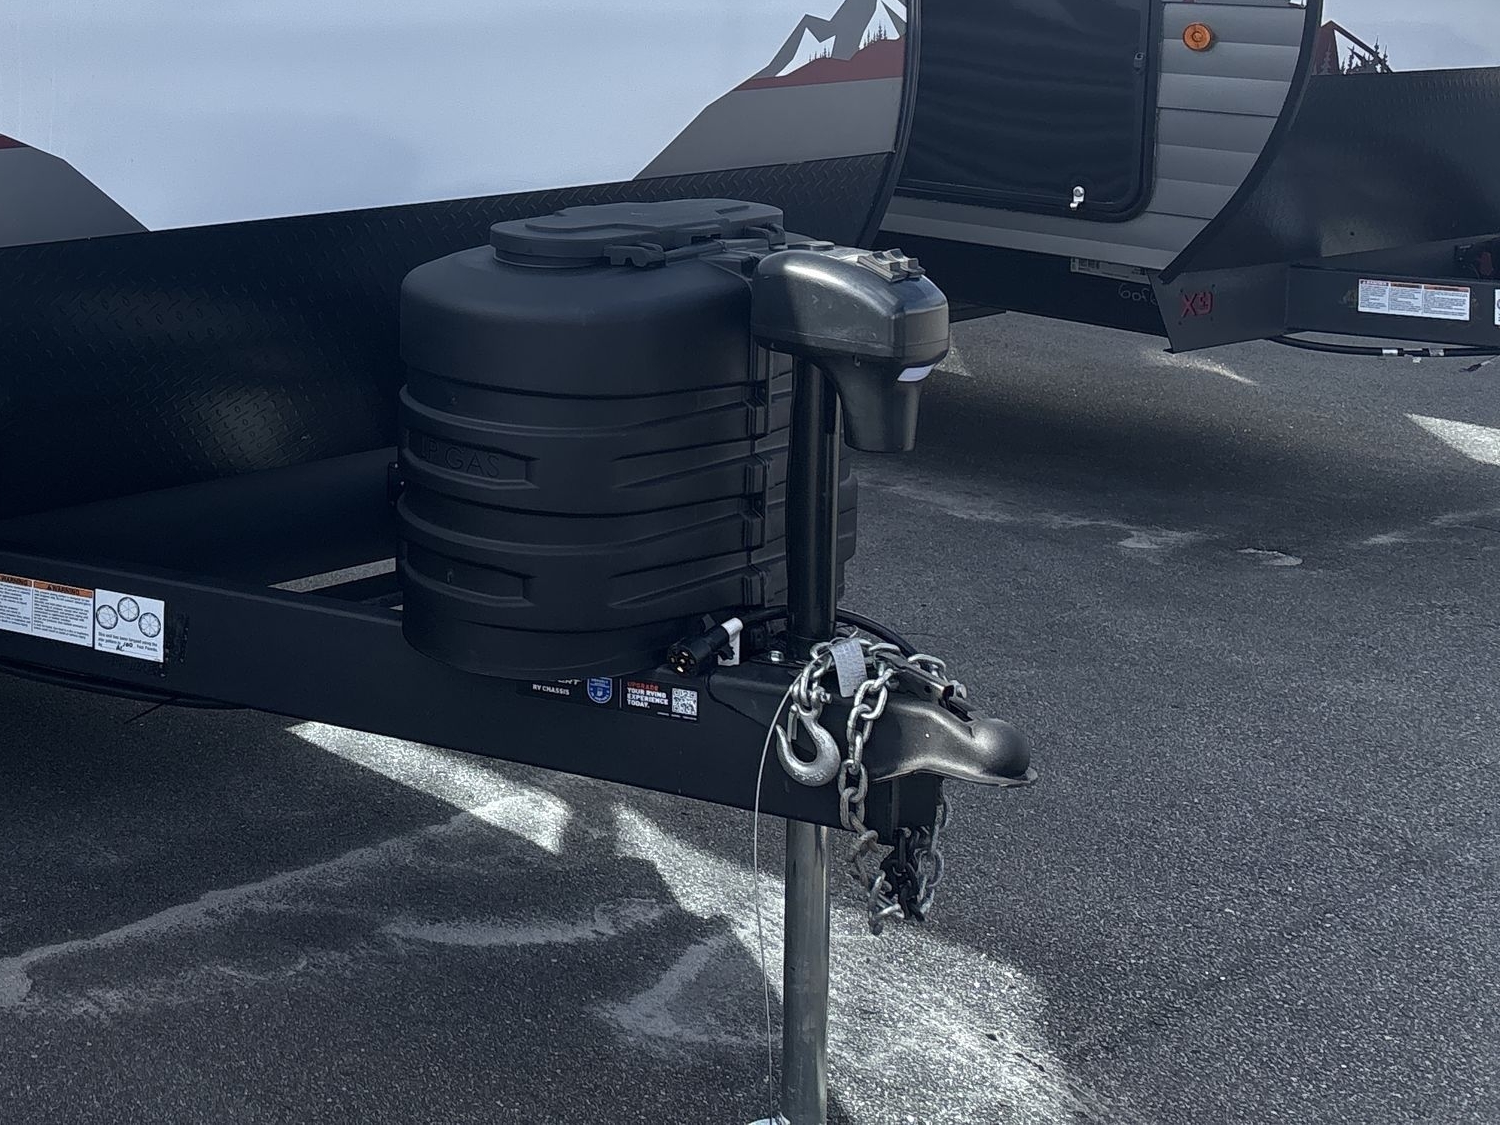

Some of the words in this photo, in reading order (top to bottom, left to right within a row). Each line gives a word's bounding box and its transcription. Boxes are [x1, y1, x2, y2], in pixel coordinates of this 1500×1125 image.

[1181, 291, 1214, 318] X9
[445, 445, 500, 478] GAS
[51, 585, 80, 595] WARNING
[532, 683, 542, 691] RV
[542, 685, 570, 696] CHASSIS
[627, 681, 659, 691] UPGRADE
[627, 687, 645, 695] YOUR
[646, 689, 667, 699] RVING
[627, 693, 669, 706] EXPERIENCE
[627, 698, 651, 709] TODAY.
